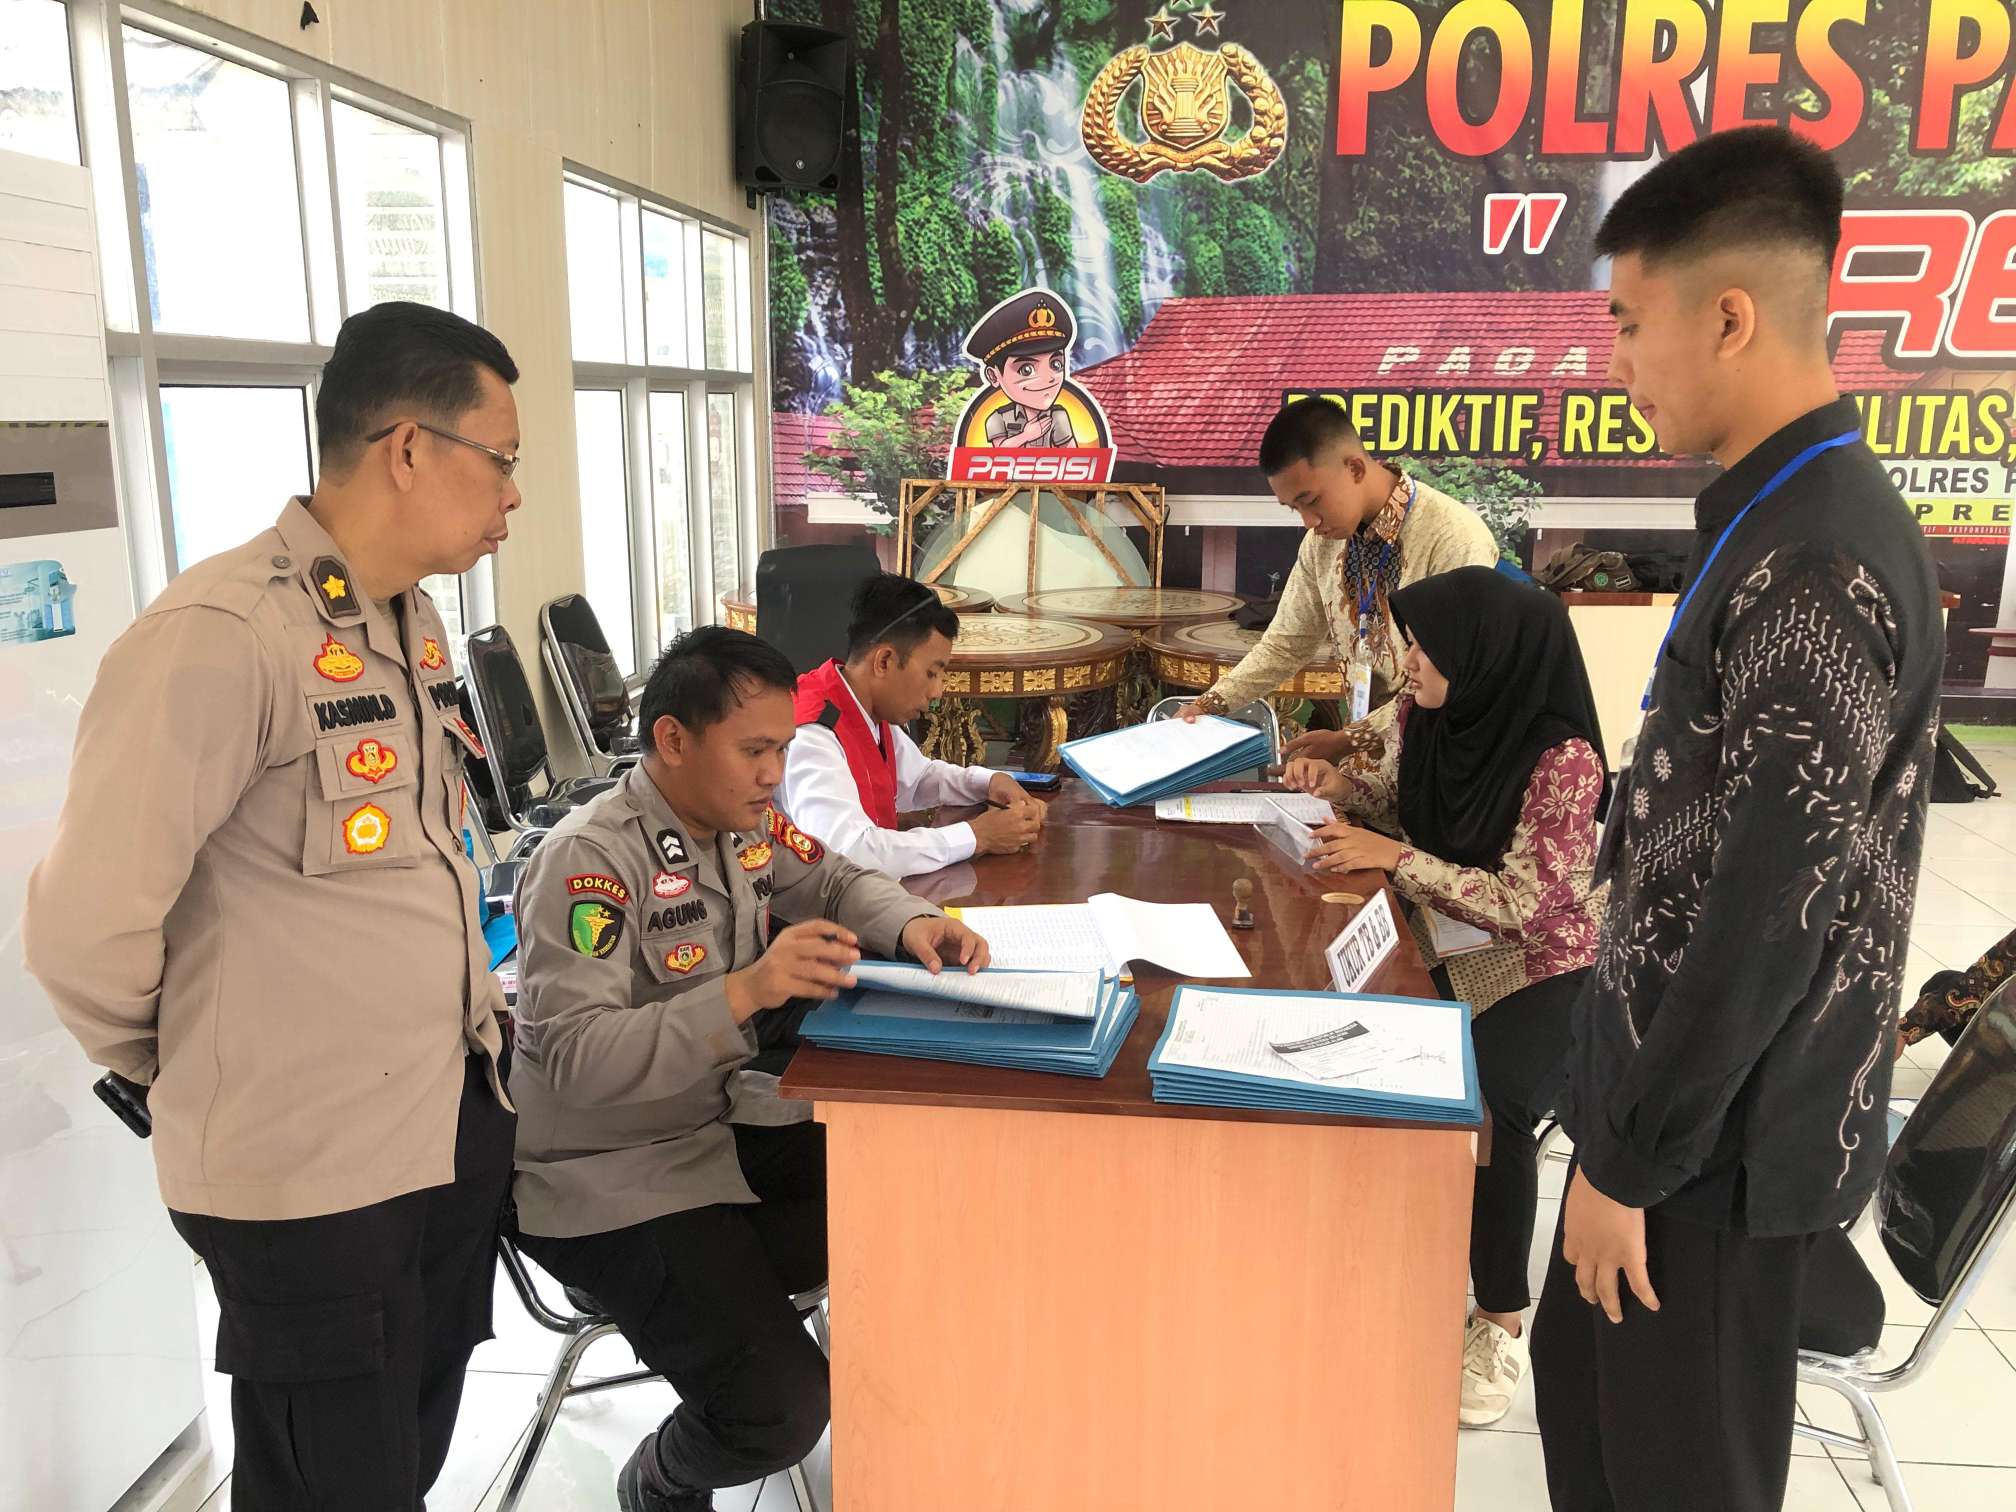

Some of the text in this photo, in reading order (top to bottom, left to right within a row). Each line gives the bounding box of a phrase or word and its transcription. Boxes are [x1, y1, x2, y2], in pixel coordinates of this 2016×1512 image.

[1336, 0, 2016, 156] POLRES P
[1287, 394, 1543, 460] EDIKTIF,
[1564, 395, 1664, 454] RES
[968, 456, 1098, 481] PRESISI
[573, 877, 626, 899] DOKKES
[647, 899, 707, 932] AGUNG
